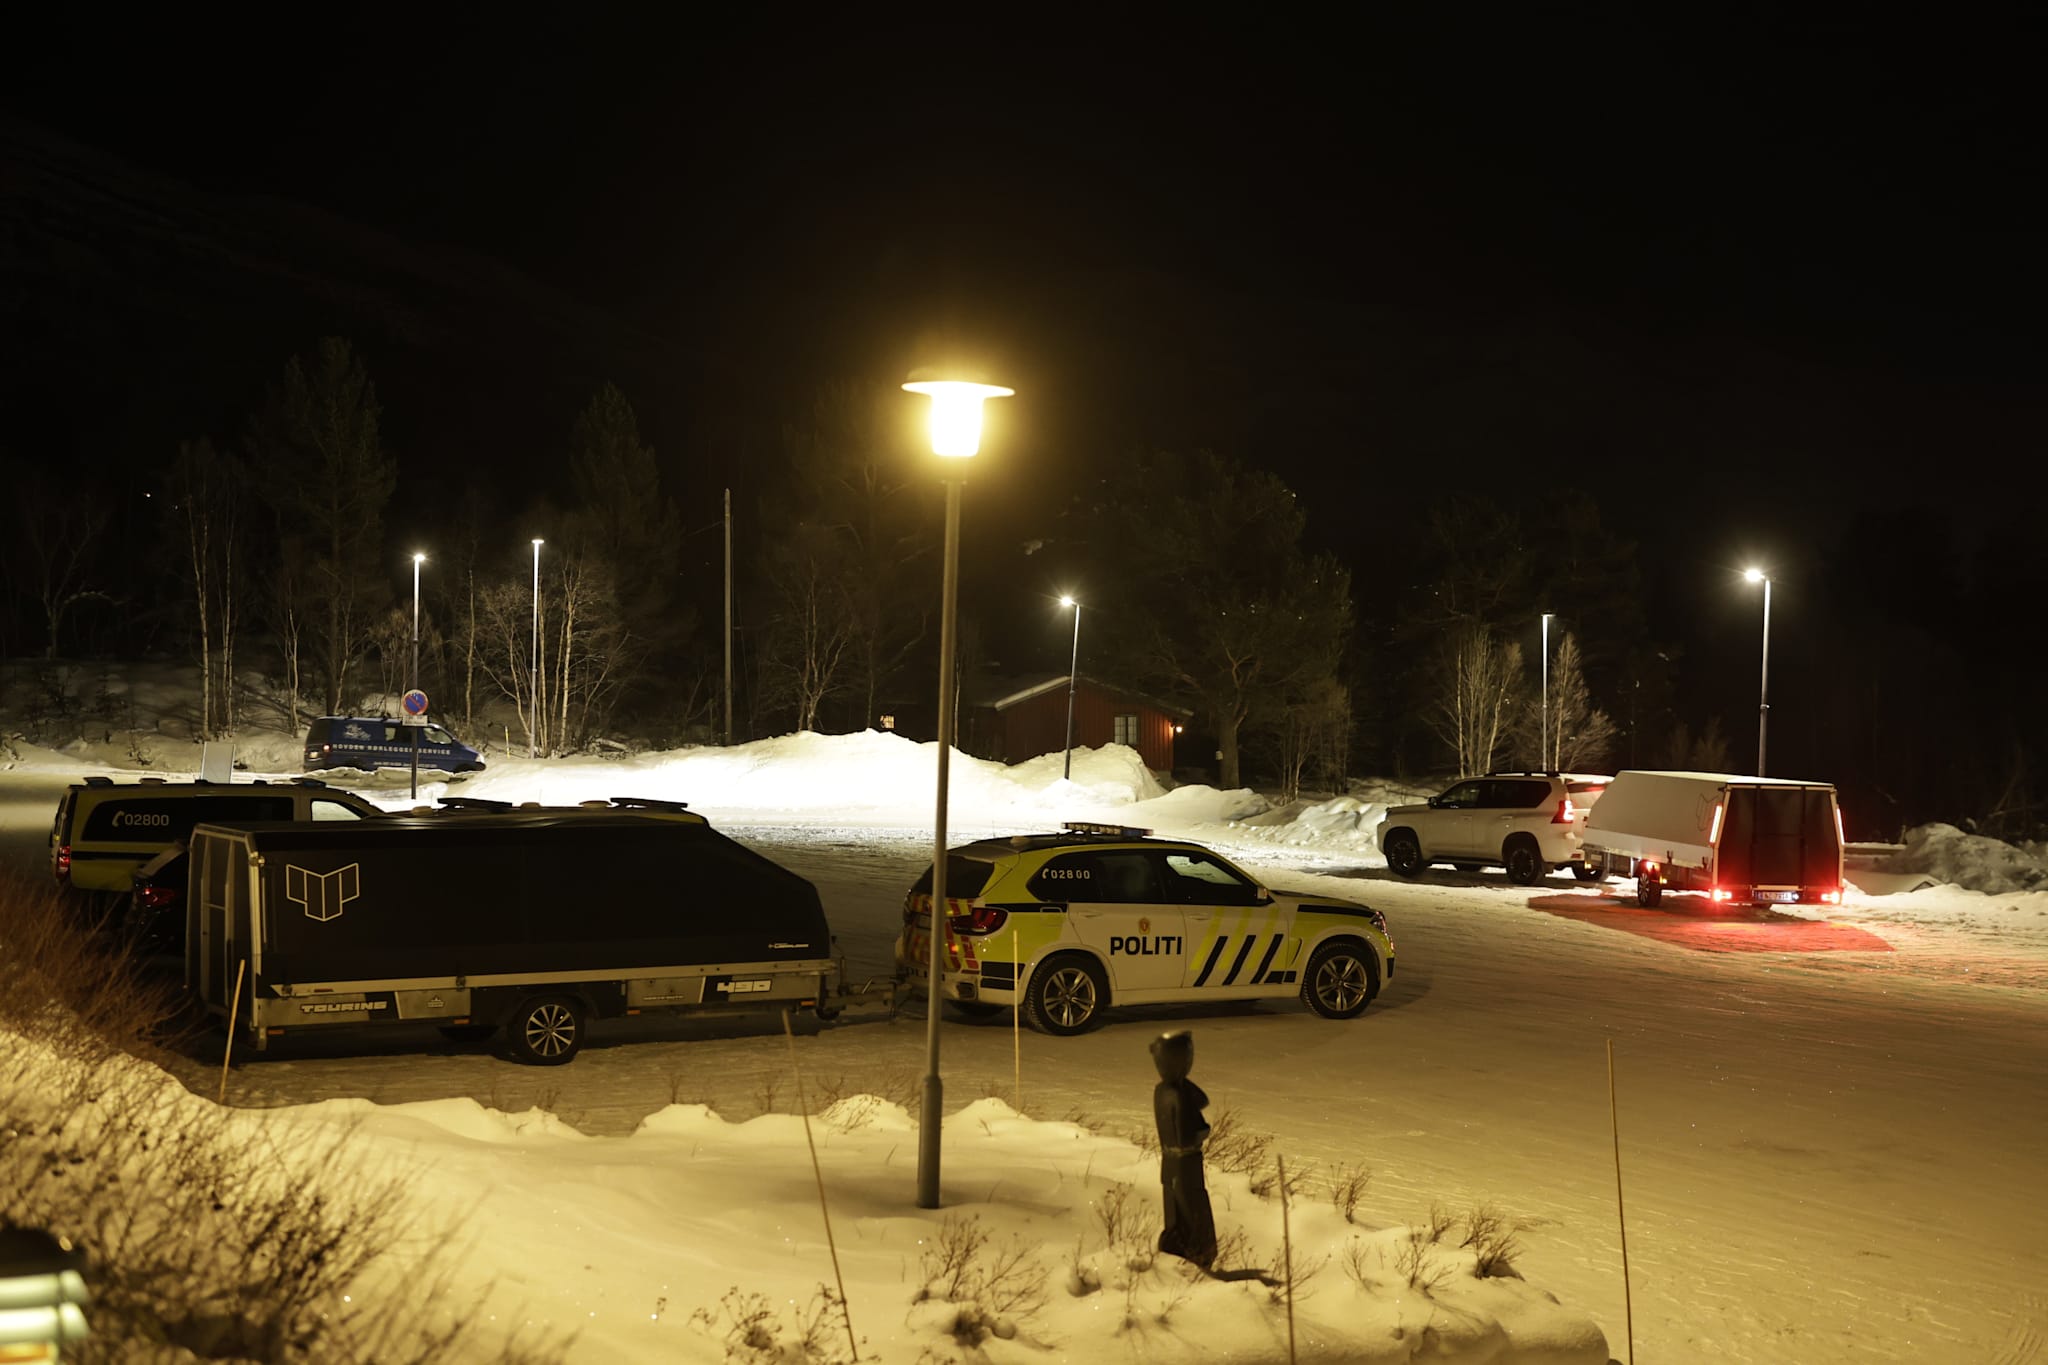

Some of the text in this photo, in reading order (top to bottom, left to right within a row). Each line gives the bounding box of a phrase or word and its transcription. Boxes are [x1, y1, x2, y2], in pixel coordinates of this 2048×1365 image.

[124, 813, 170, 826] 02800
[1050, 869, 1090, 880] 02800
[1110, 936, 1182, 955] POLITI
[301, 1001, 388, 1013] TOURING
